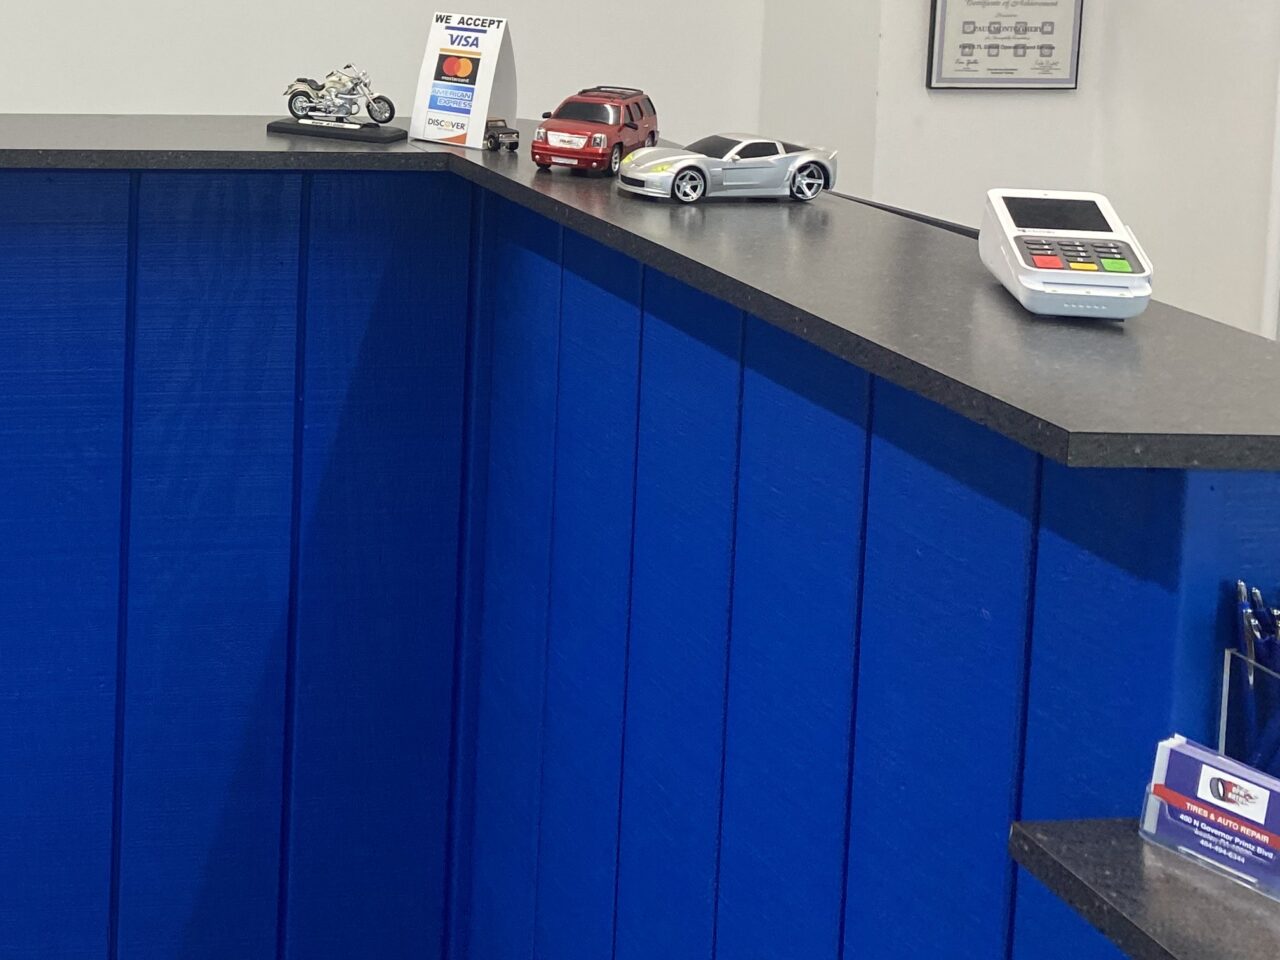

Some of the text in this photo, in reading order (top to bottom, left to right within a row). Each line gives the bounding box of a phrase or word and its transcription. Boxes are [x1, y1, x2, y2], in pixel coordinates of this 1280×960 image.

[435, 14, 503, 29] WE ACCEPT
[448, 33, 480, 48] VISA
[432, 88, 471, 98] AMERICAN
[438, 98, 472, 109] EXPRESS
[427, 118, 466, 131] DISCOVER
[1185, 802, 1209, 818] TIRES
[1209, 812, 1216, 821] &
[1217, 816, 1240, 831] AUTO
[1240, 826, 1270, 844] REPAIR
[1193, 818, 1200, 827] N
[1200, 822, 1234, 842] Governor
[1234, 836, 1256, 851] Printz
[1256, 845, 1275, 859] Blvd
